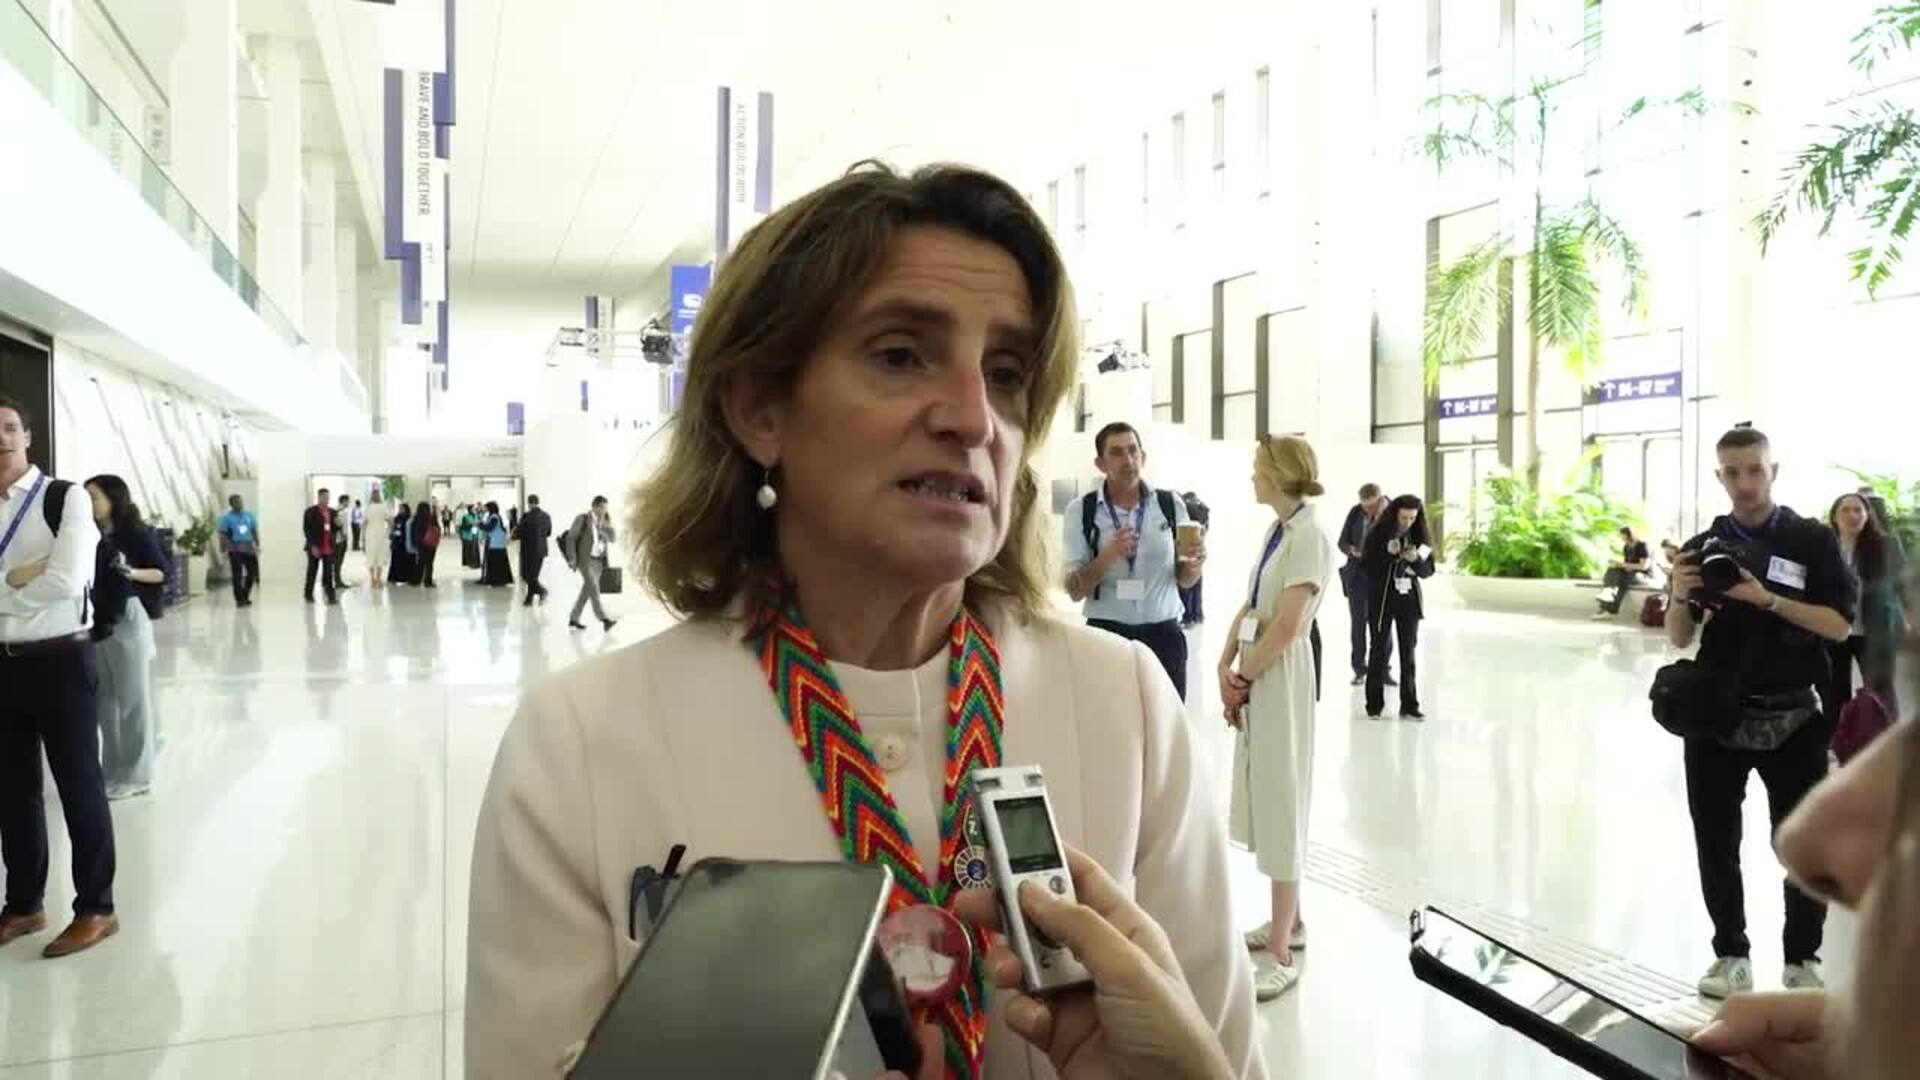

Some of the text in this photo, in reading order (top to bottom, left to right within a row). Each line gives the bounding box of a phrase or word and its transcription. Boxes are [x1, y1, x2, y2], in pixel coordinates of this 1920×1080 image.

[418, 106, 430, 129] AND
[418, 130, 430, 158] BOLD
[418, 162, 430, 216] TOGETHER
